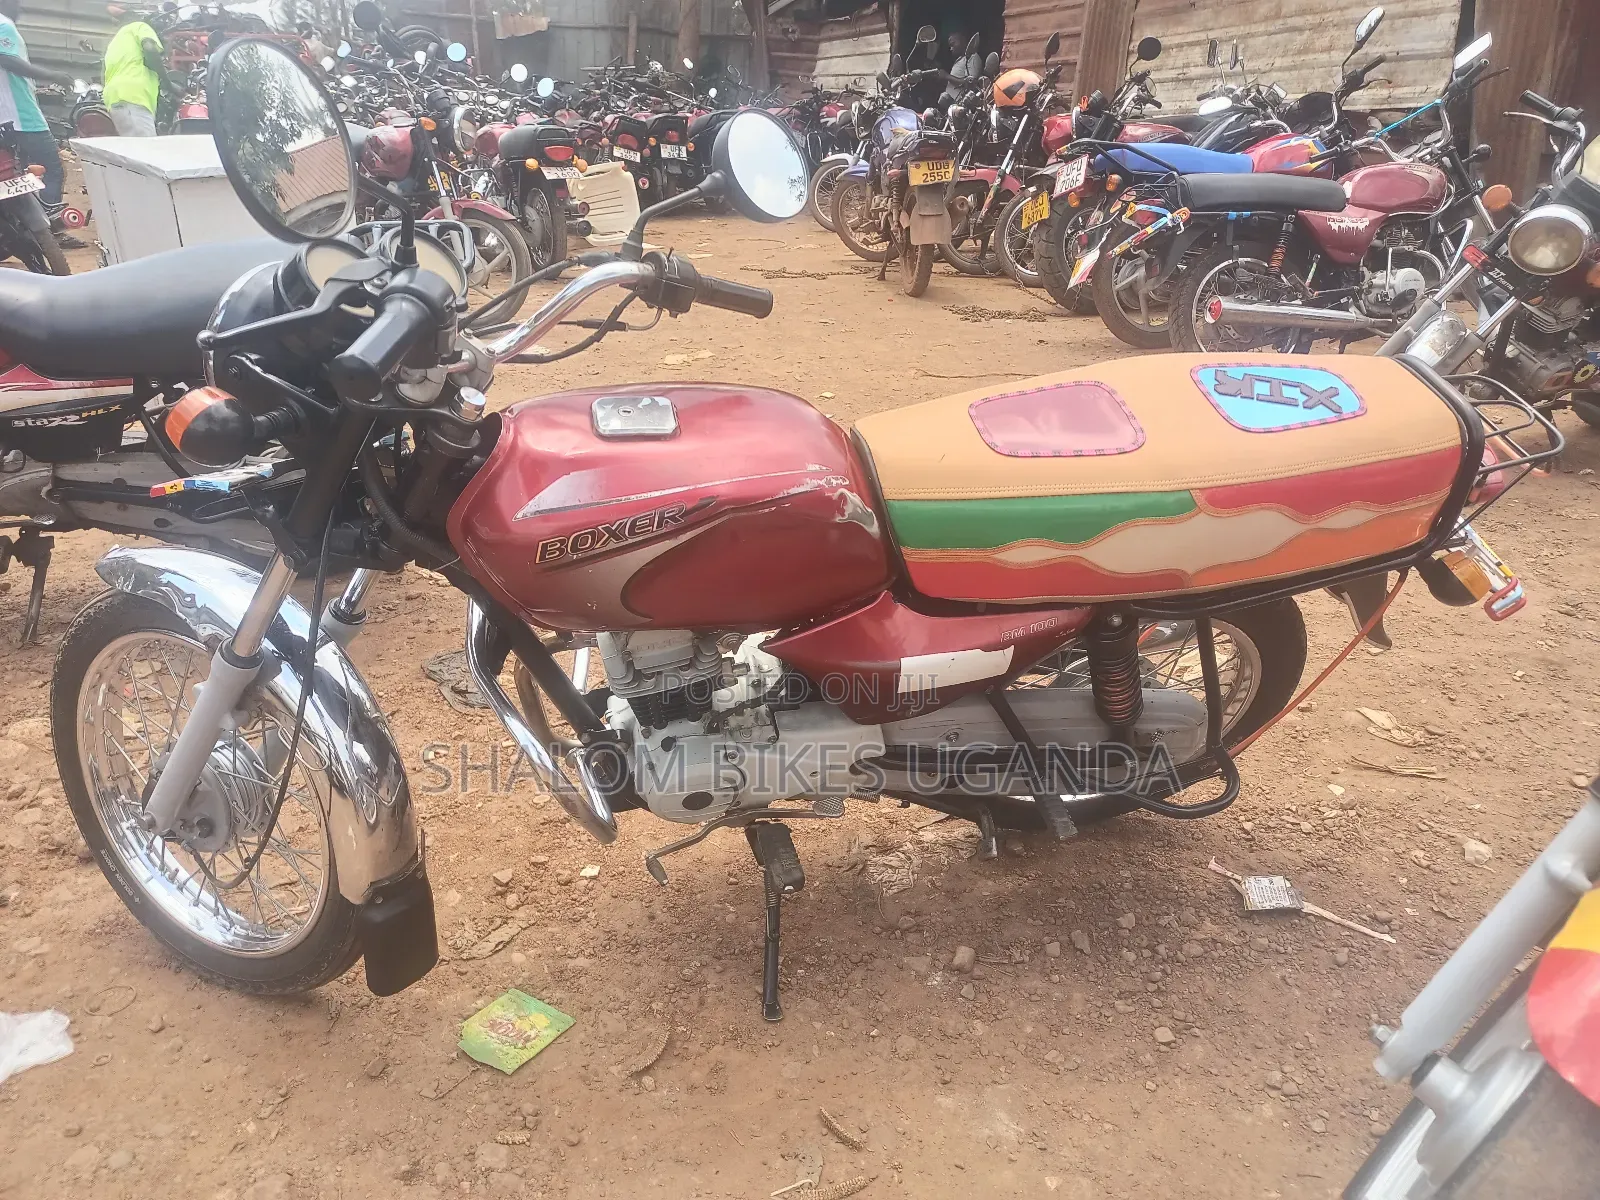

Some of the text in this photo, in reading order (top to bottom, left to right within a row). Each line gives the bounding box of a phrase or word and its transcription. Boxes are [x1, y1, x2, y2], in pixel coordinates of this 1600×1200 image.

[921, 170, 951, 183] 255C
[81, 404, 122, 418] HLX
[535, 501, 687, 564] BOXER
[1000, 626, 1027, 643] BM
[1029, 617, 1059, 634] 100
